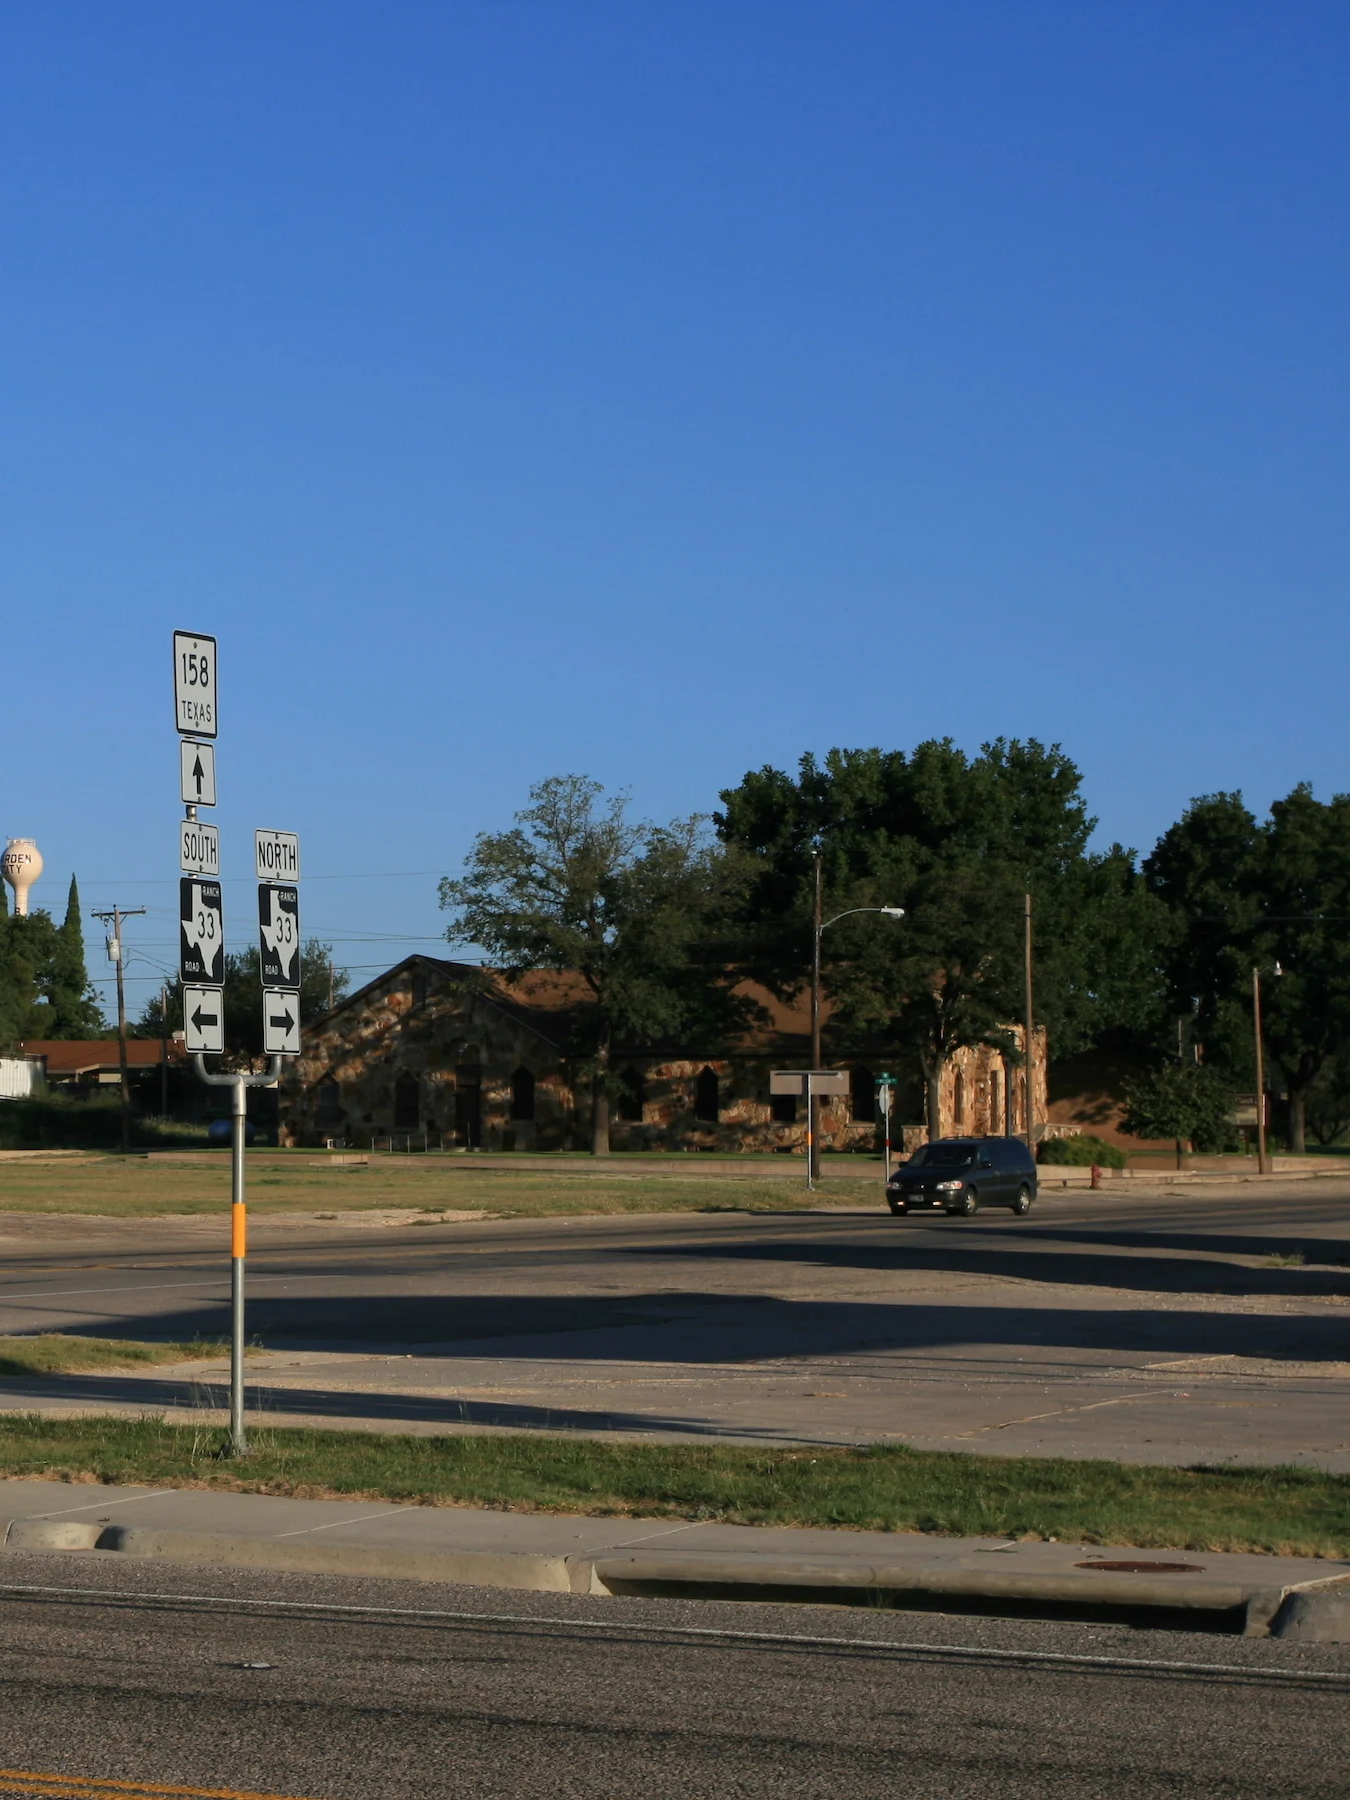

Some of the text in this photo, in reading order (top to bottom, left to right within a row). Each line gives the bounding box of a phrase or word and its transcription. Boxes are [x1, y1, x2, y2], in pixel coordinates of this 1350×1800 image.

[182, 653, 209, 688] 158
[181, 700, 212, 723] TEXAS
[183, 832, 217, 865] SOUTH
[258, 841, 297, 871] NORTH
[202, 886, 220, 898] RANCH
[280, 891, 297, 902] RANCH
[197, 911, 215, 940] 33
[276, 916, 292, 943] 33
[185, 961, 200, 972] ROAD
[265, 965, 279, 976] ROAD
